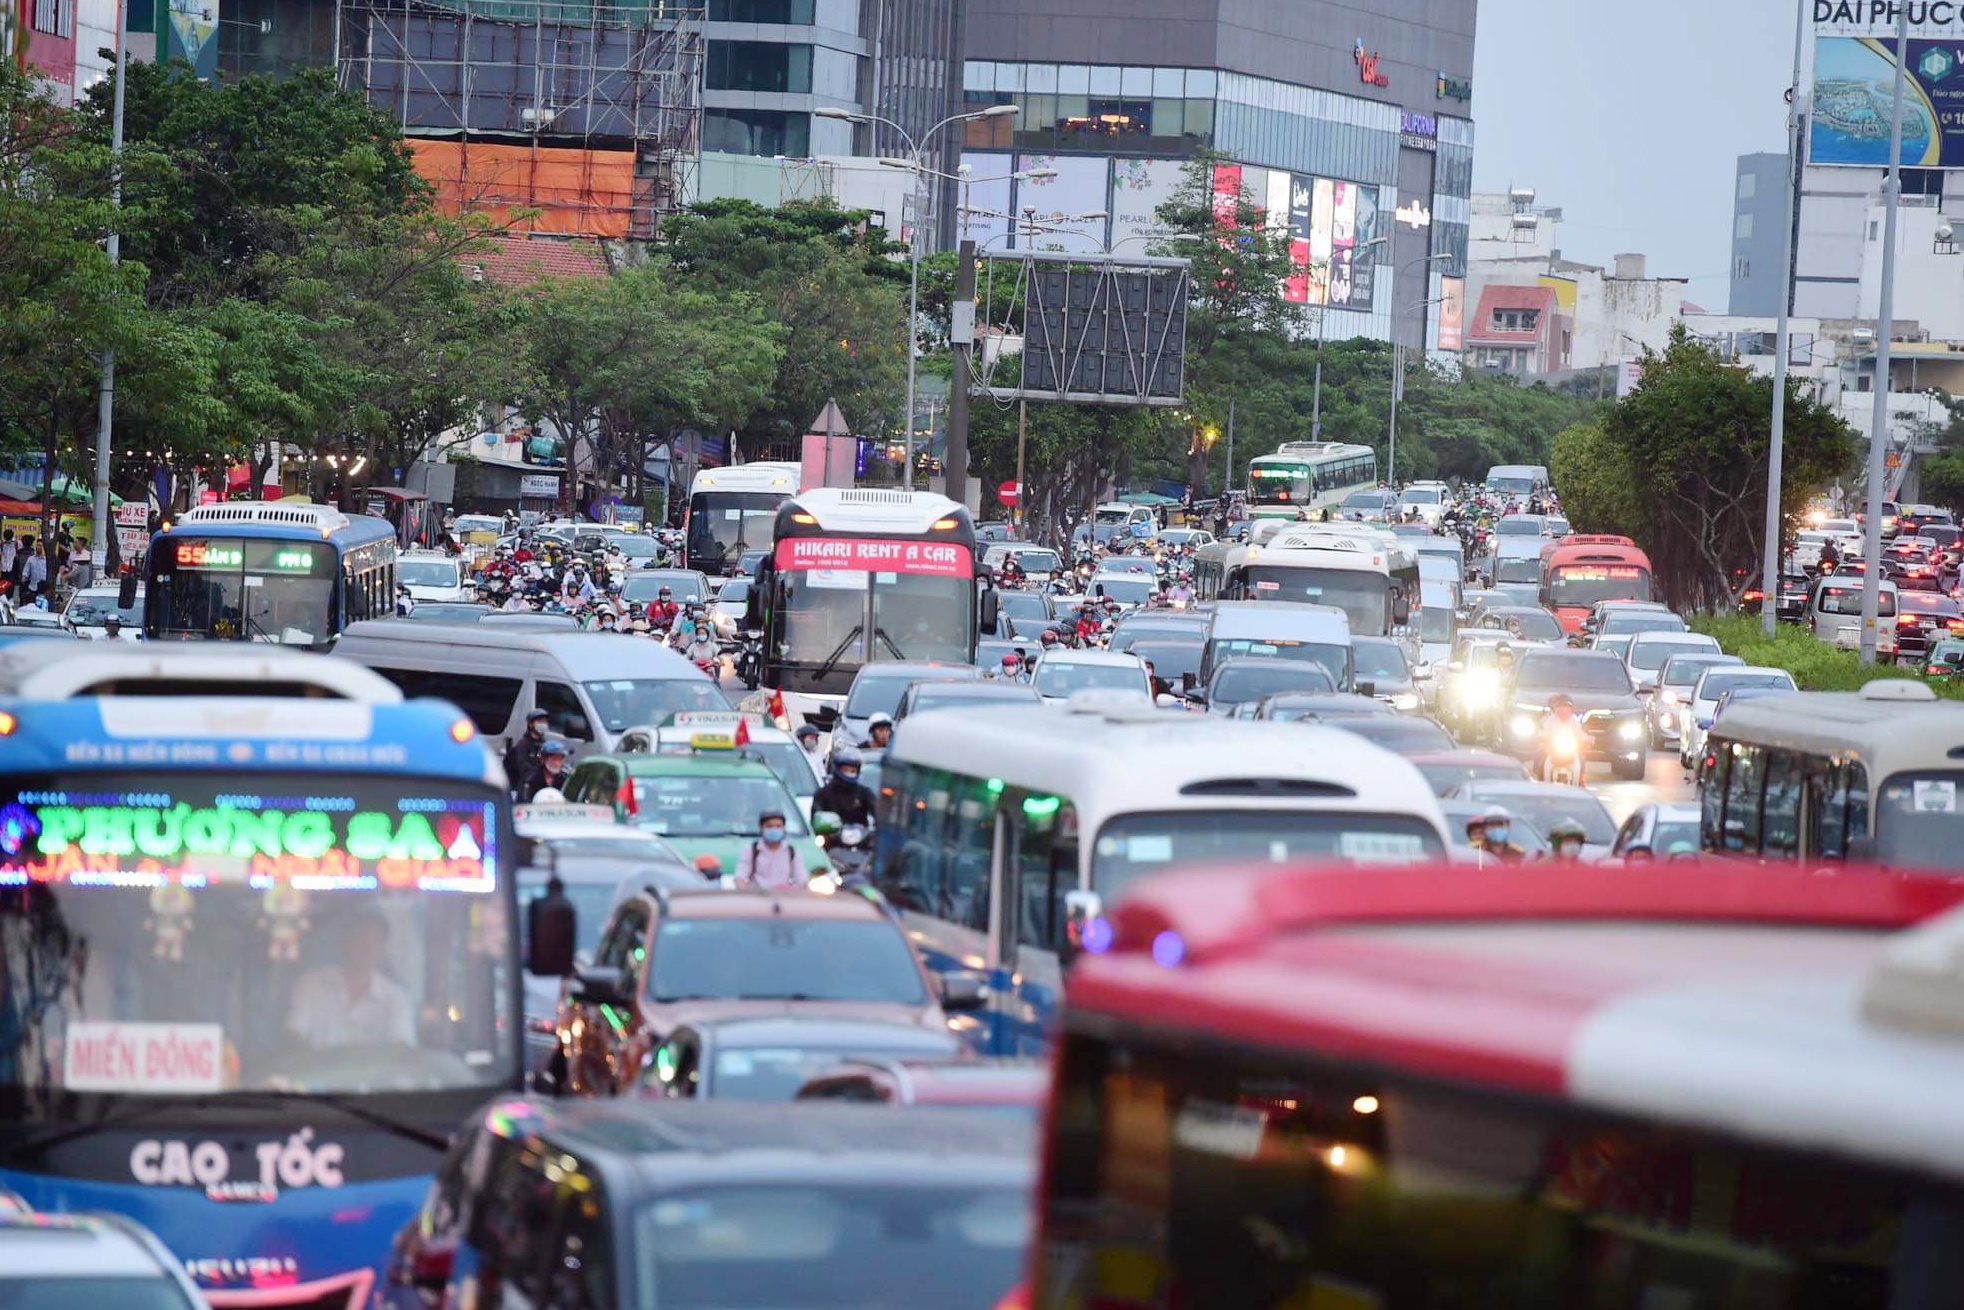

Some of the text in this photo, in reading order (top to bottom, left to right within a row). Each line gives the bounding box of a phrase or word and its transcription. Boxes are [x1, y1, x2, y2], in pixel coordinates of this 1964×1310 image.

[1119, 213, 1149, 223] PEARL
[134, 507, 146, 518] XE
[177, 545, 206, 563] 55
[793, 541, 957, 563] HIKARI RENT A CAR
[129, 1126, 345, 1188] CAO TỐC
